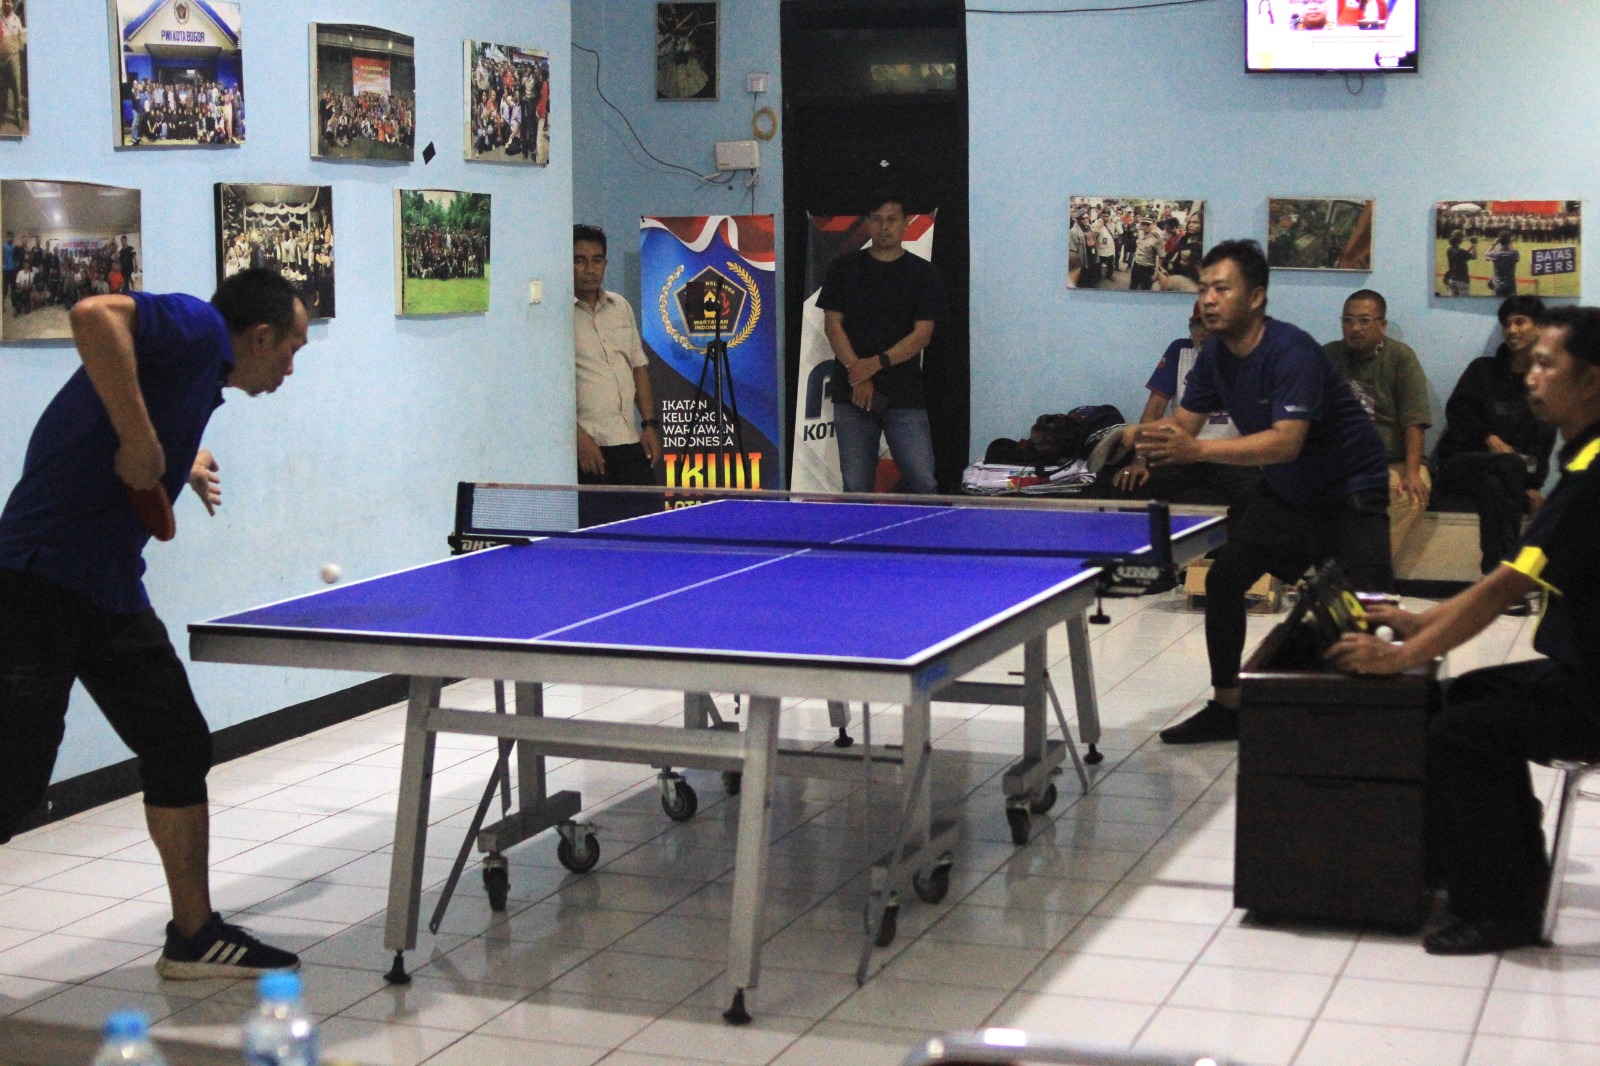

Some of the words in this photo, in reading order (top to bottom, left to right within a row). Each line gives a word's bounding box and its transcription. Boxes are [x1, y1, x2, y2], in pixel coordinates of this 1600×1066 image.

[161, 29, 172, 41] PWI
[172, 31, 186, 41] KOTA
[186, 31, 205, 42] BOGOR
[1535, 249, 1572, 262] BATAS
[1534, 260, 1573, 274] PERS
[705, 281, 735, 295] KELRGA
[662, 399, 707, 410] IKATAN
[803, 421, 835, 441] KOT
[663, 436, 734, 447] INDONESA
